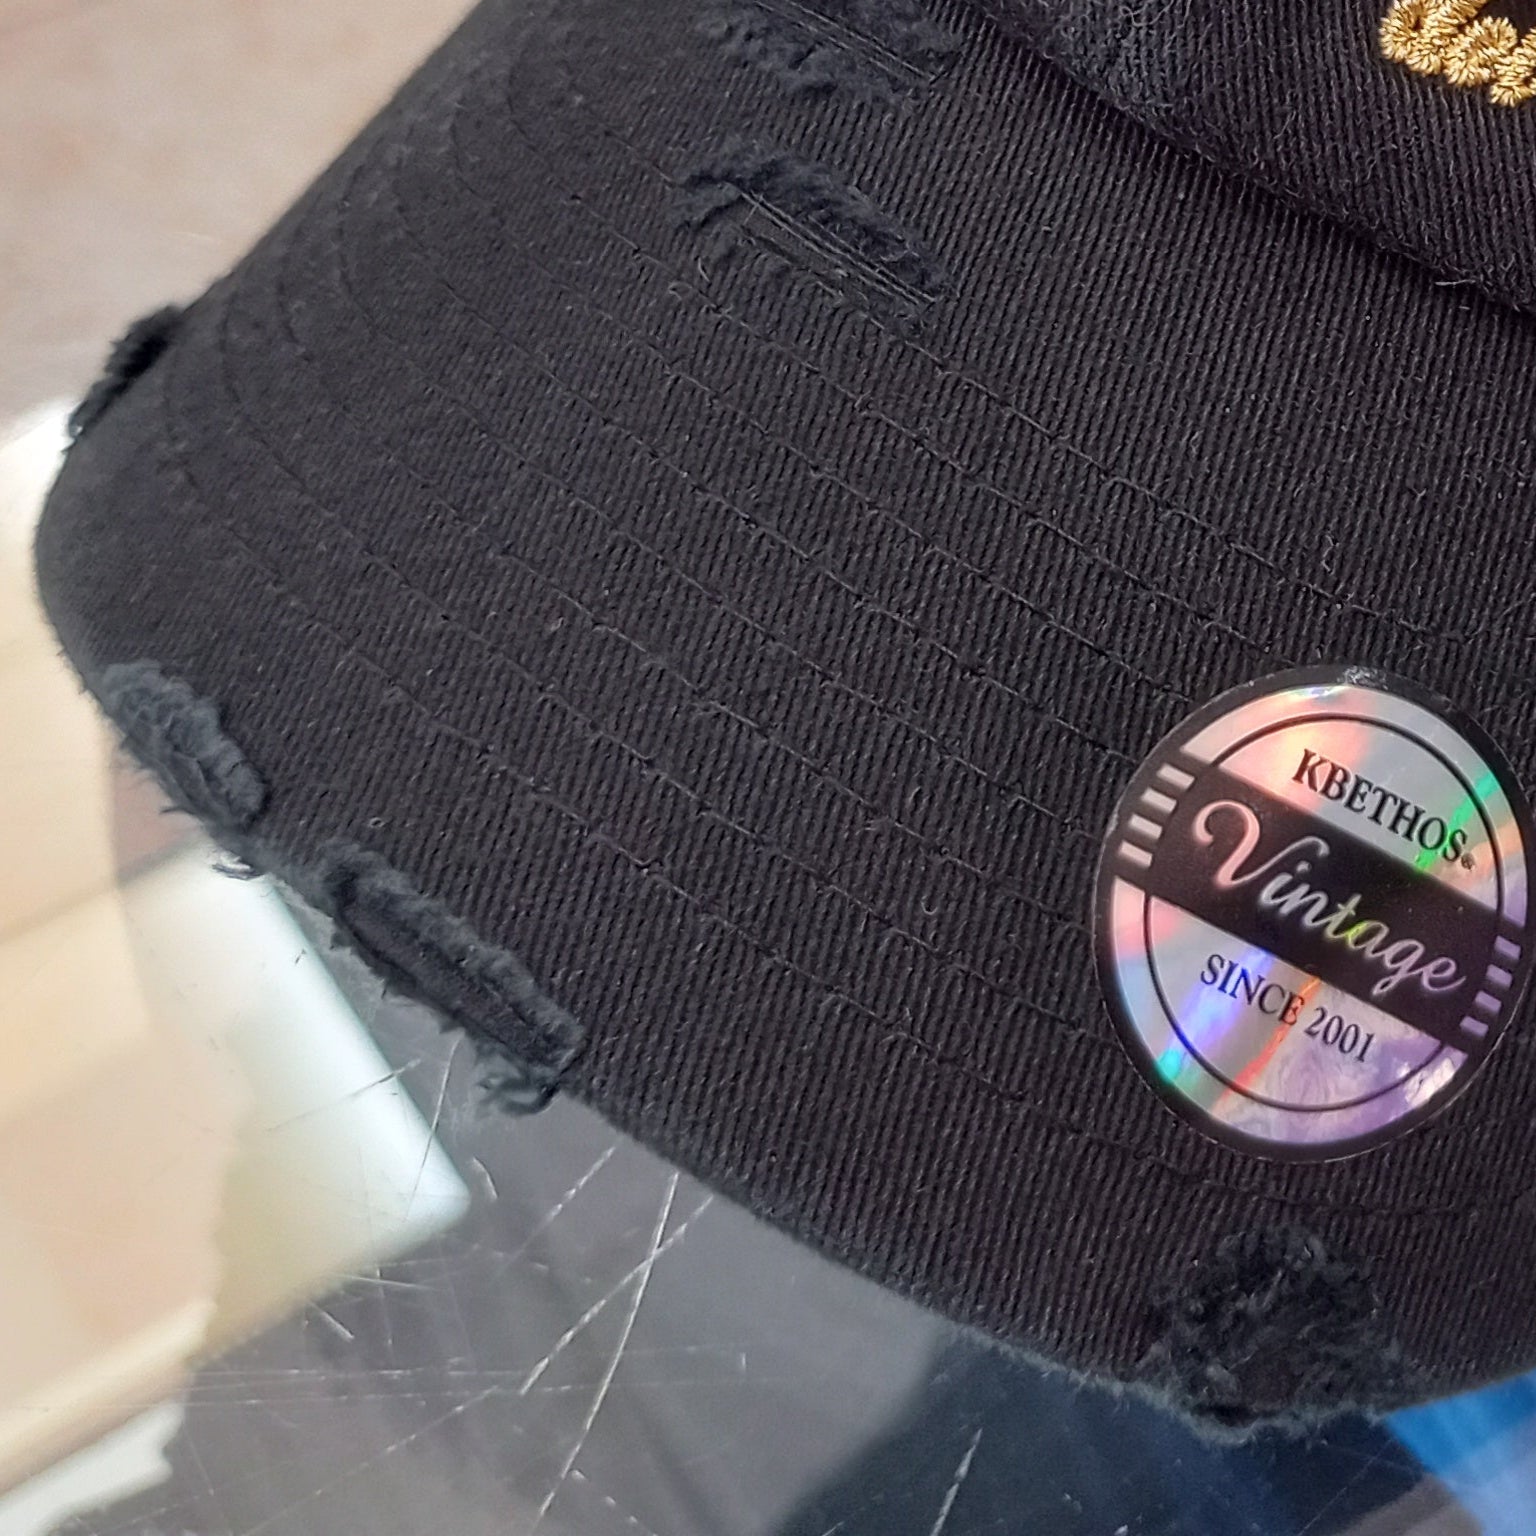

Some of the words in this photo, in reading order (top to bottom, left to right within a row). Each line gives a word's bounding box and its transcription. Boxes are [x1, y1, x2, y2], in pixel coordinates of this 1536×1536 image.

[1193, 799, 1467, 997] Vintage
[1200, 954, 1304, 1027] SINCE
[1305, 1007, 1374, 1063] 2001
